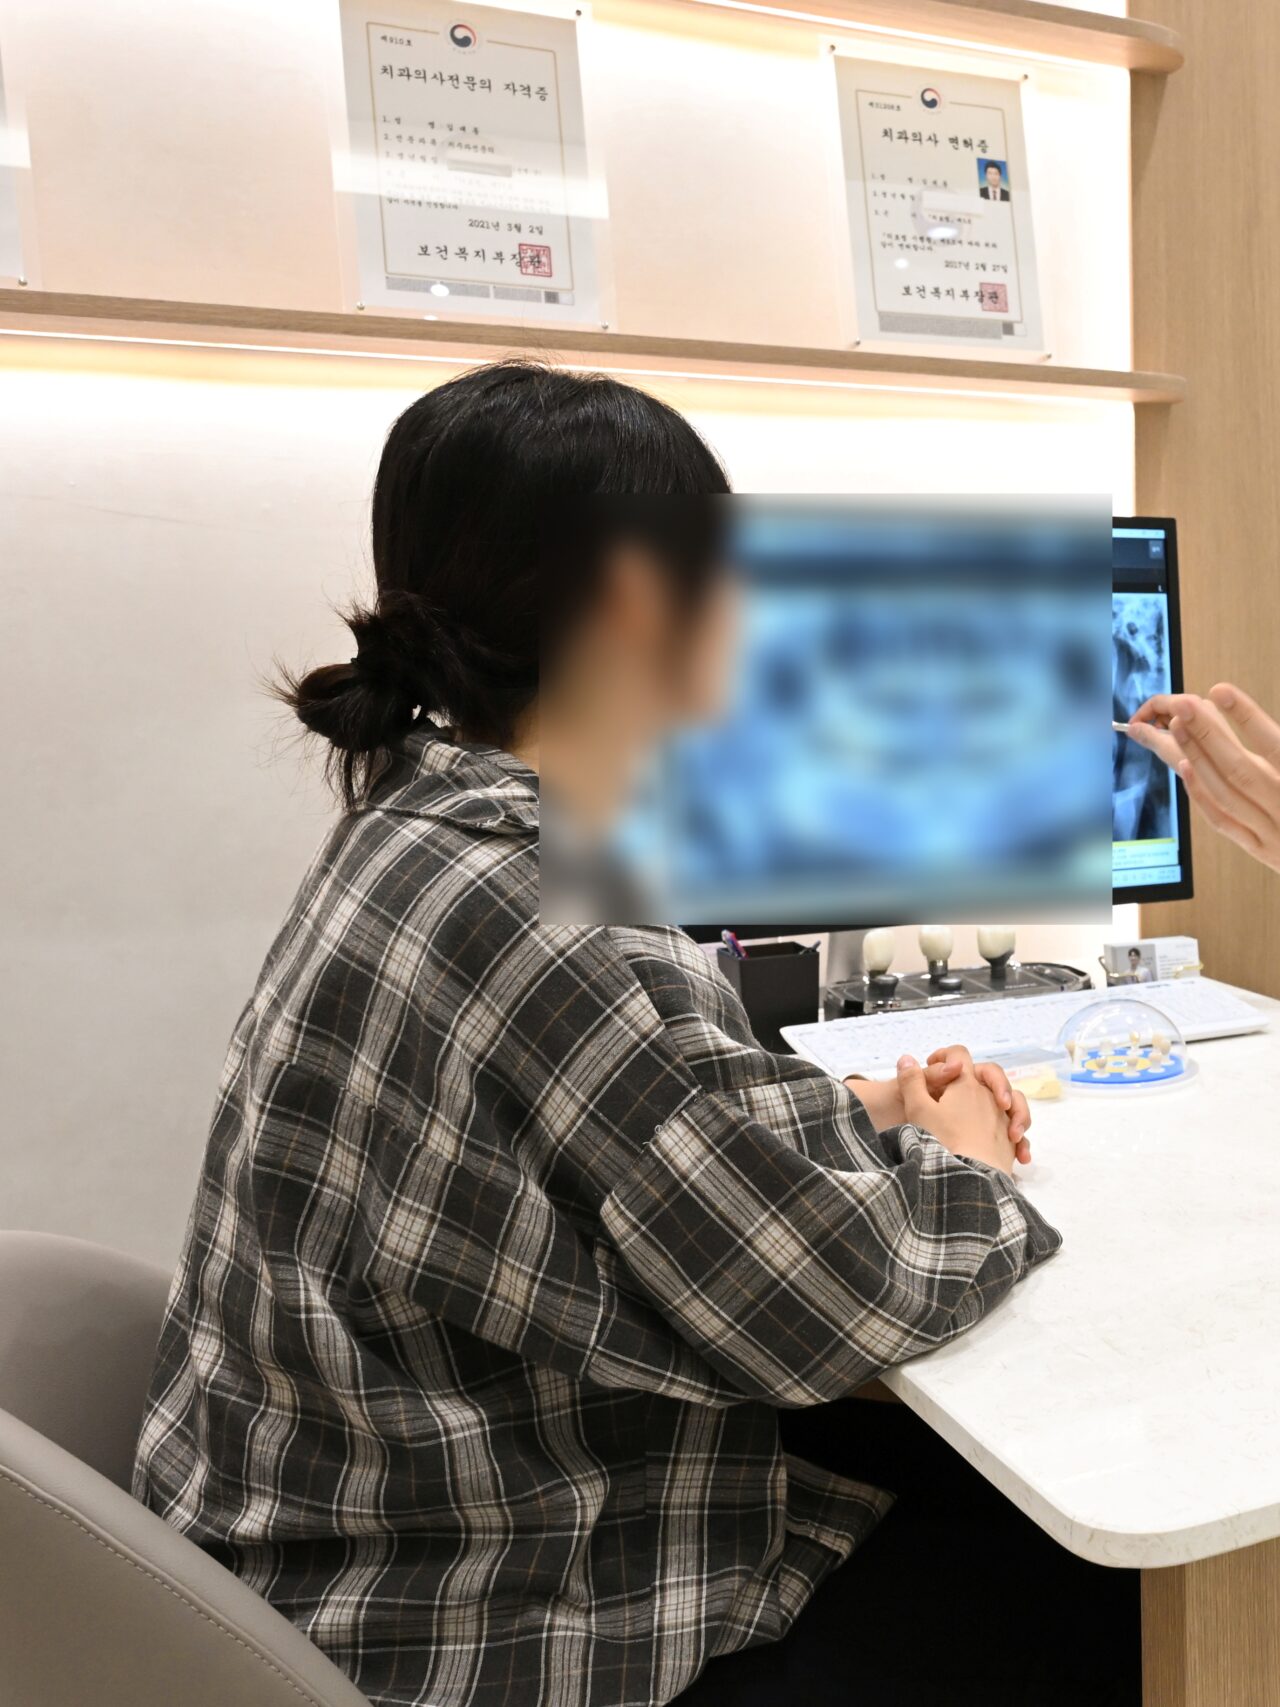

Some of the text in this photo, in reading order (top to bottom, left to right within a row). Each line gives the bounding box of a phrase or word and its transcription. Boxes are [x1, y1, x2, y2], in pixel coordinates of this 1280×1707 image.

[380, 64, 548, 101] 치과의사전문의 자격증
[881, 127, 989, 154] 치과의사 면허증
[468, 218, 501, 232] 2021년
